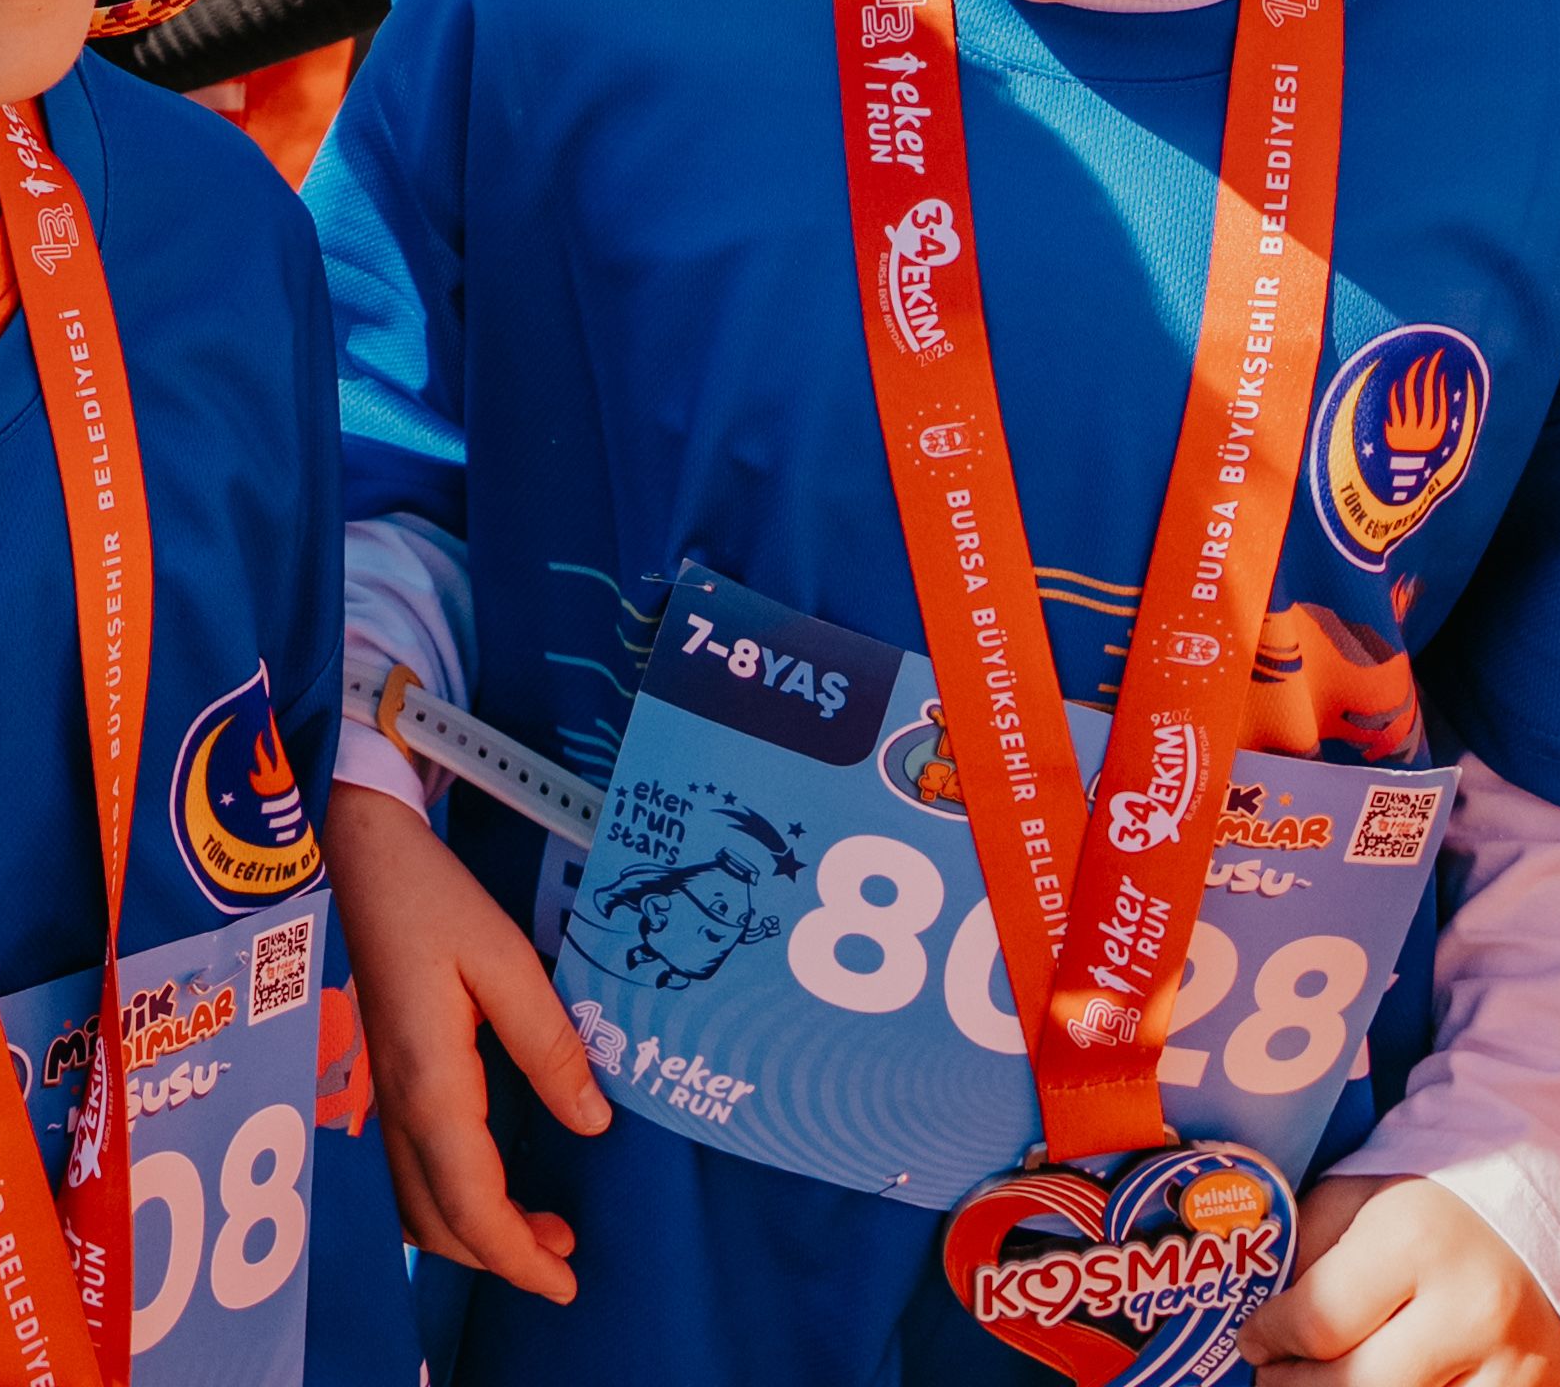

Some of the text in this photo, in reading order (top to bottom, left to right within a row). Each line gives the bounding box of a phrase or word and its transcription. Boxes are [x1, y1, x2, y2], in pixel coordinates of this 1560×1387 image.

[0, 101, 38, 171] eke
[865, 101, 894, 165] RUN
[891, 80, 932, 175] eker
[900, 264, 946, 352] EKİM
[1191, 62, 1300, 602] BURSA BÜYÜKŞEHİR BELEDİYESİ
[915, 339, 955, 369] 2026
[58, 307, 117, 512] BELEDİYESİ
[1338, 482, 1368, 527] TÜRK
[101, 529, 127, 761] BÜYÜKŞEHİR
[945, 489, 989, 595] BURSA
[970, 606, 1038, 805] BÜYÜKŞEHİR
[1146, 724, 1186, 805] EKİM
[632, 780, 694, 818] eker
[632, 803, 687, 844] run
[201, 833, 234, 875] TÜRK
[234, 856, 298, 883] EĞİTİM
[606, 820, 682, 867] stars
[1214, 813, 1334, 851] MLAR
[1098, 874, 1148, 967] eker
[1130, 896, 1173, 979] I RUN
[658, 1052, 756, 1104] eker
[667, 1085, 734, 1125] RUN
[1192, 1182, 1253, 1208] MİNİK
[1192, 1200, 1259, 1220] ADIMLAR
[86, 1242, 107, 1309] RUN
[981, 1228, 1275, 1323] KOŞMAK
[1191, 1326, 1241, 1380] BURSA
